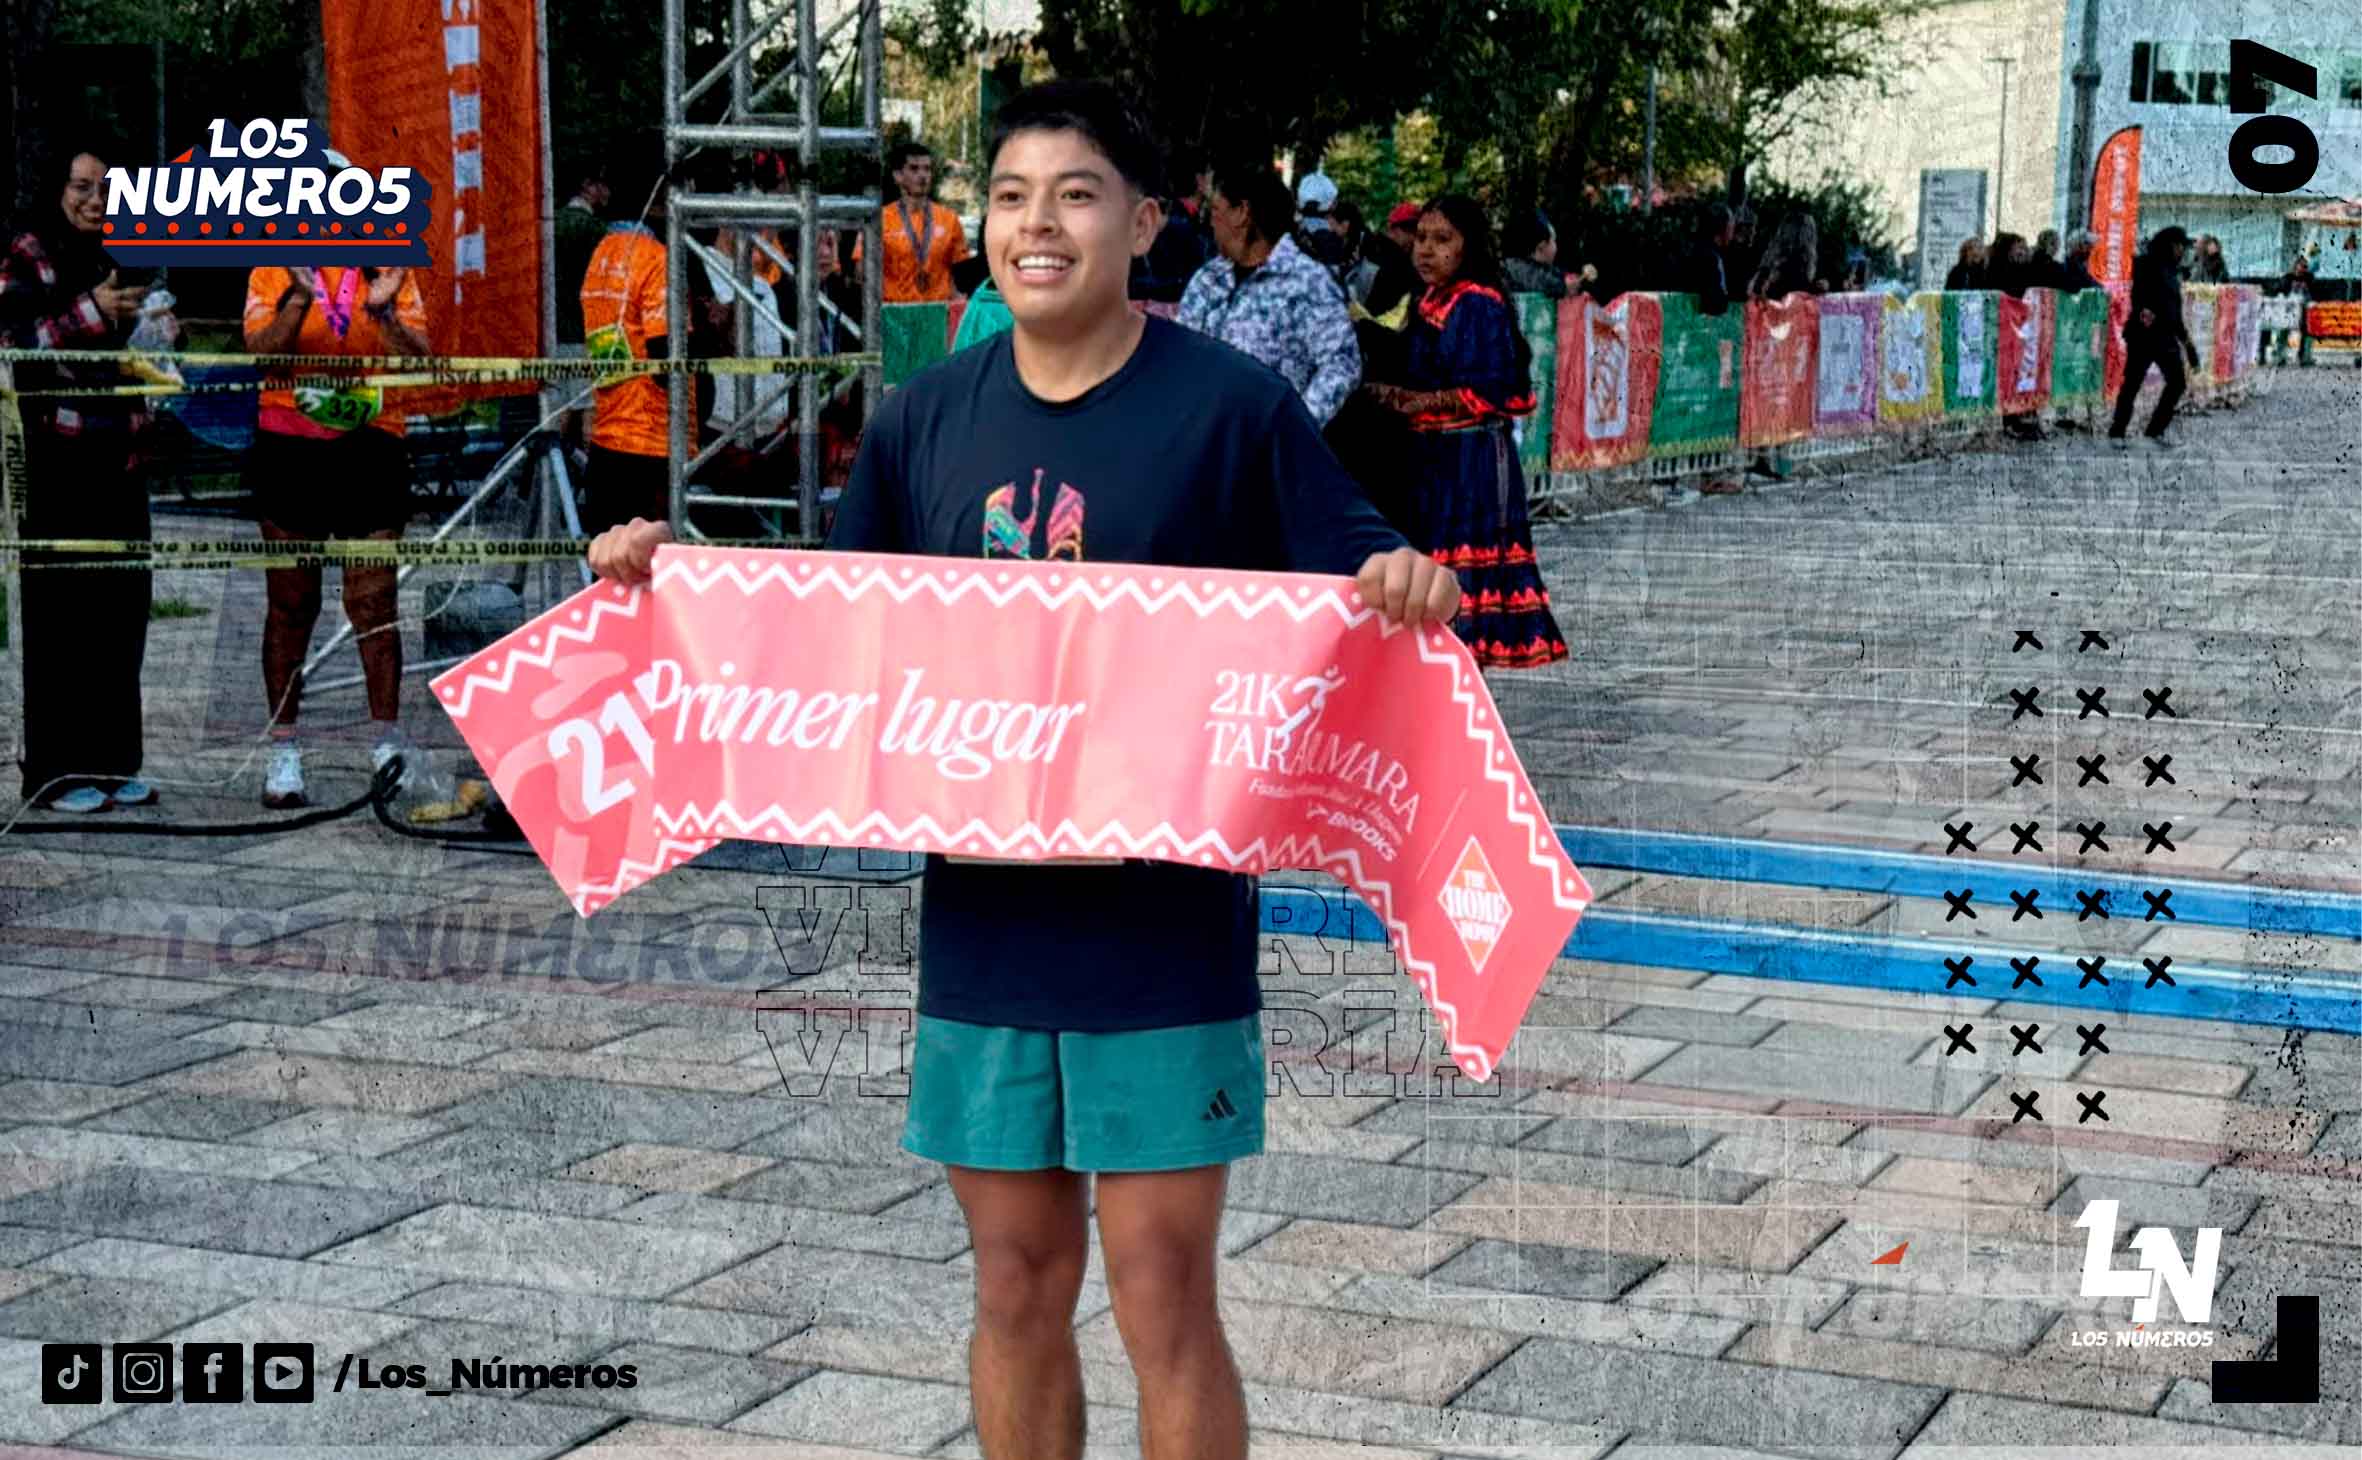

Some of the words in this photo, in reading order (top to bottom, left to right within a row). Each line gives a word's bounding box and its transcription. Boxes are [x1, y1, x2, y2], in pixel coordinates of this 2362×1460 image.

[650, 658, 880, 751] Primer
[878, 666, 1087, 782] lugar
[1209, 670, 1294, 720] 21K
